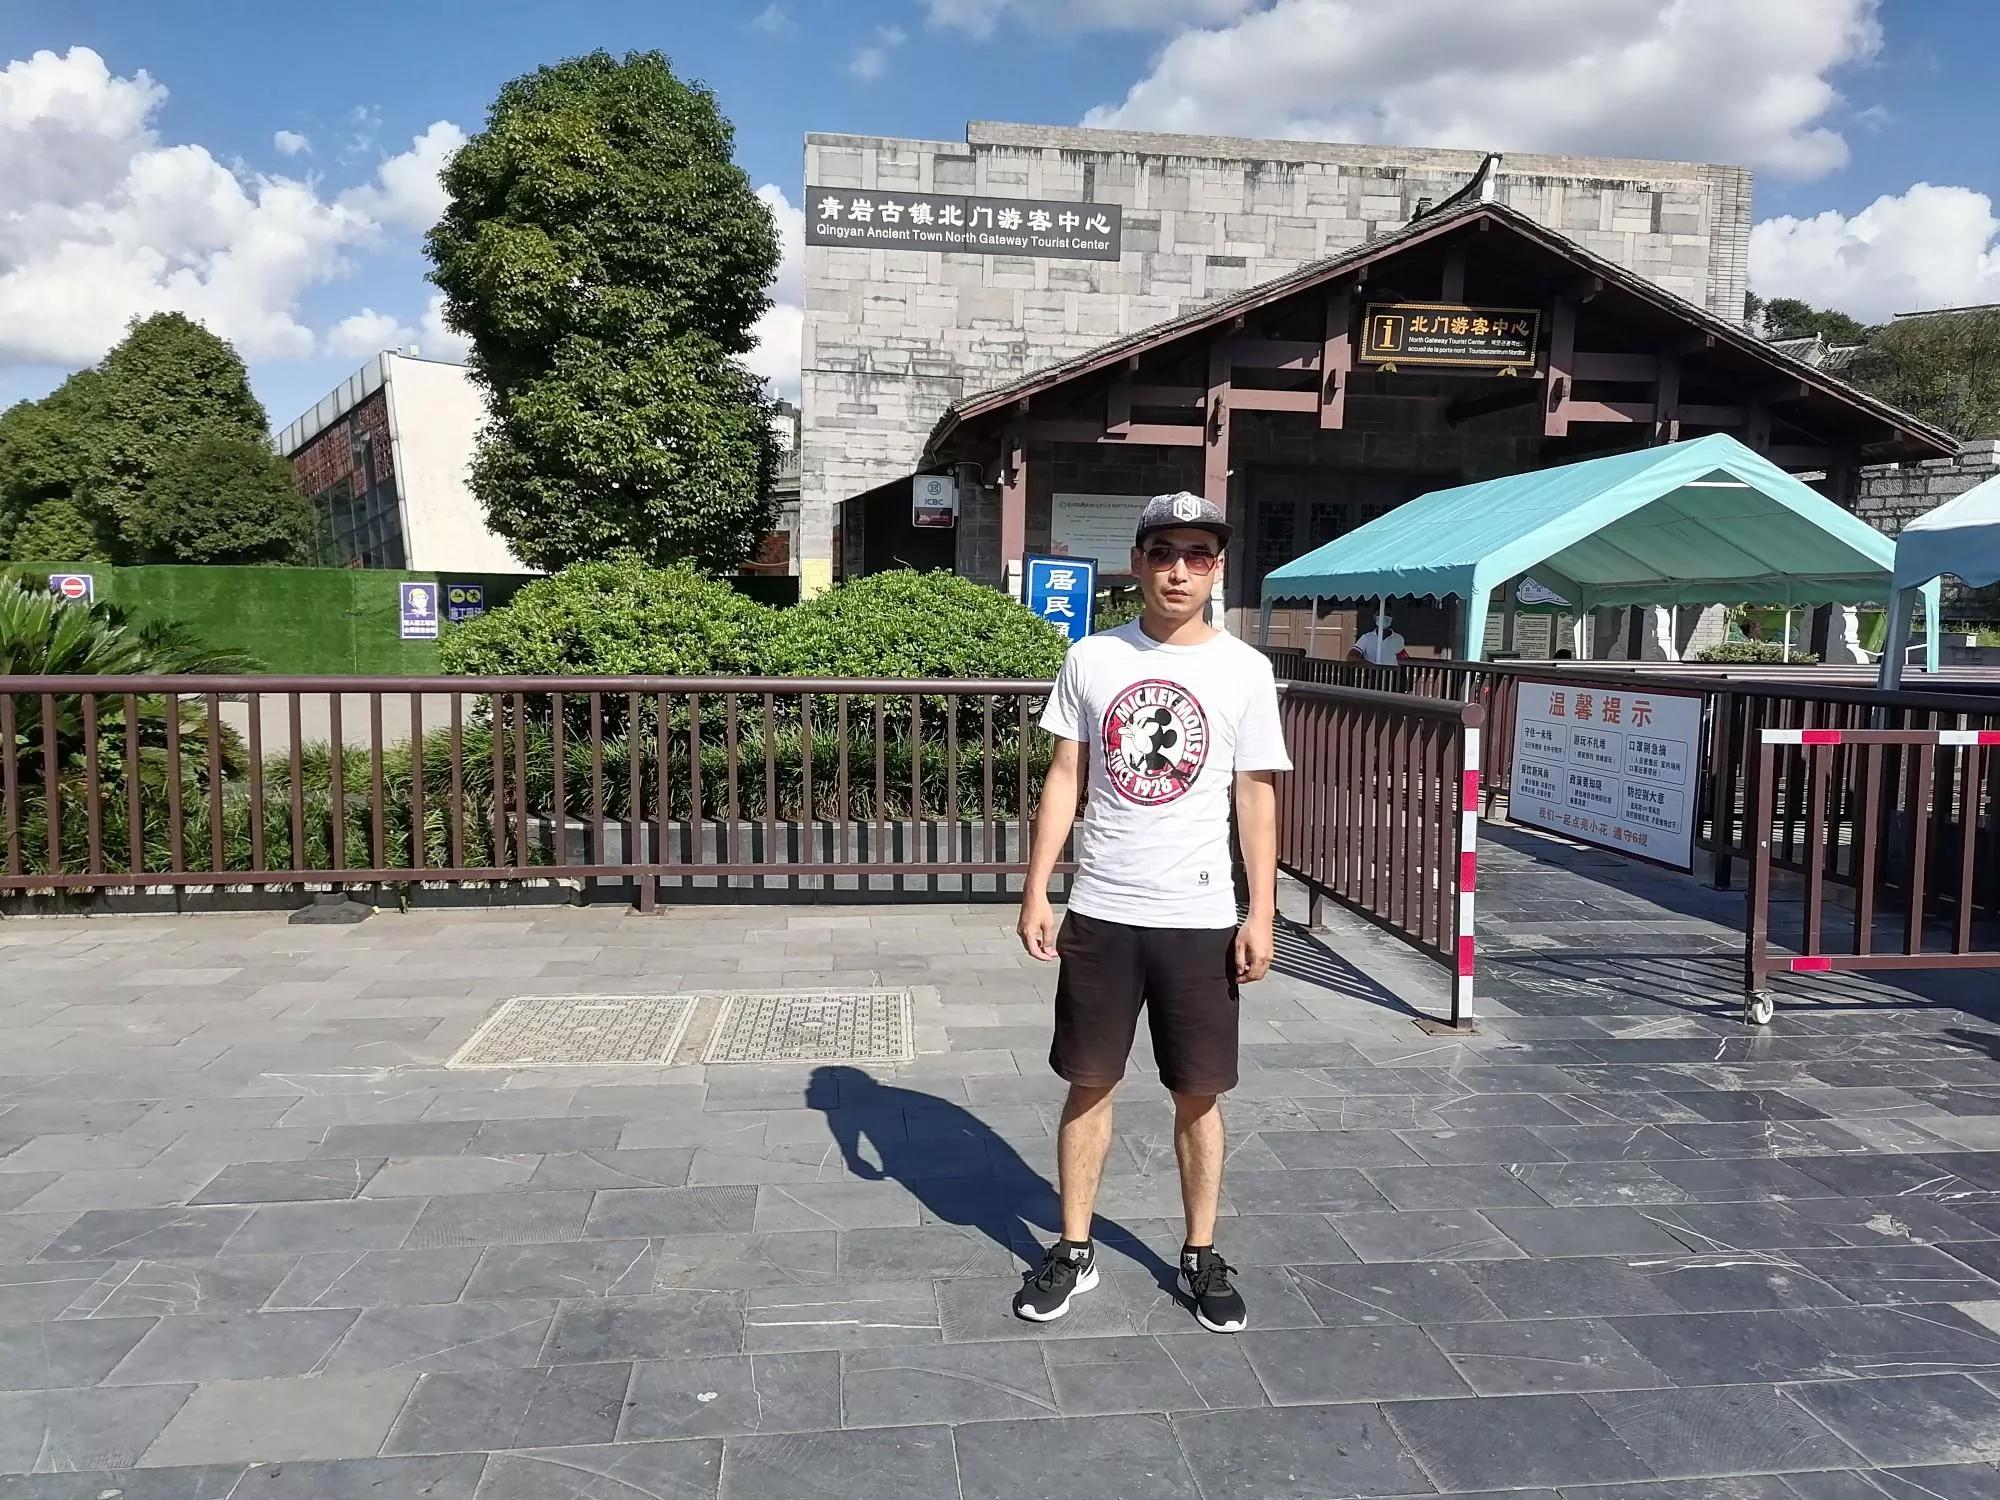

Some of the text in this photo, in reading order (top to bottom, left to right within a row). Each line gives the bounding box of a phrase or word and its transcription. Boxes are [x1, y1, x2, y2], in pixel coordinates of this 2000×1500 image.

[817, 196, 1111, 234] 青岩古镇北门游客中心
[816, 224, 1110, 250] Qingyan Ancient Town North Gateway Tourist Center
[1409, 315, 1530, 337] 北门游客中心
[1408, 336, 1486, 346] North Gateway Tourist Center
[924, 498, 944, 506] ICBC
[1549, 691, 1653, 728] 温馨提示
[1115, 687, 1202, 765] MICKEY MOUSE
[1574, 735, 1606, 749] 游玩不扎堆
[1629, 740, 1667, 757] 口罩别急摘
[1109, 748, 1173, 798] SINCE 1928
[1627, 786, 1665, 804] 防控别大意
[1538, 807, 1608, 836] 我们一起点亮小花
[1613, 826, 1648, 847] 遵守6规
